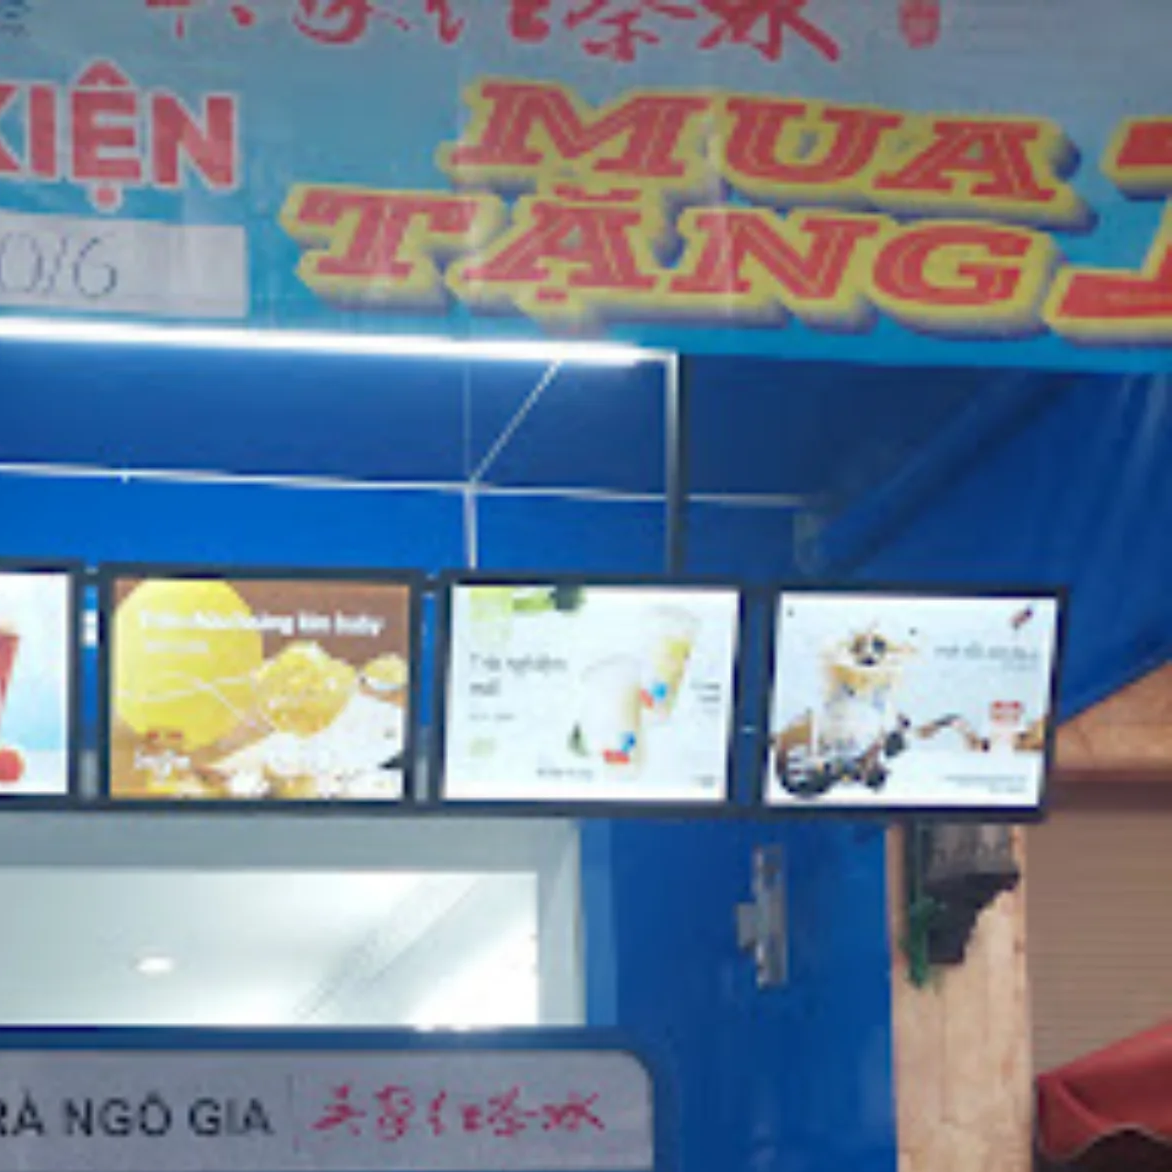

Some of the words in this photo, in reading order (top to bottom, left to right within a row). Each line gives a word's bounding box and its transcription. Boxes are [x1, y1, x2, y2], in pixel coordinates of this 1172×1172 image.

[450, 83, 1057, 202] MUA
[298, 184, 1034, 307] TẶNG
[66, 1093, 173, 1137] NGÔ
[188, 1097, 276, 1138] GIA
